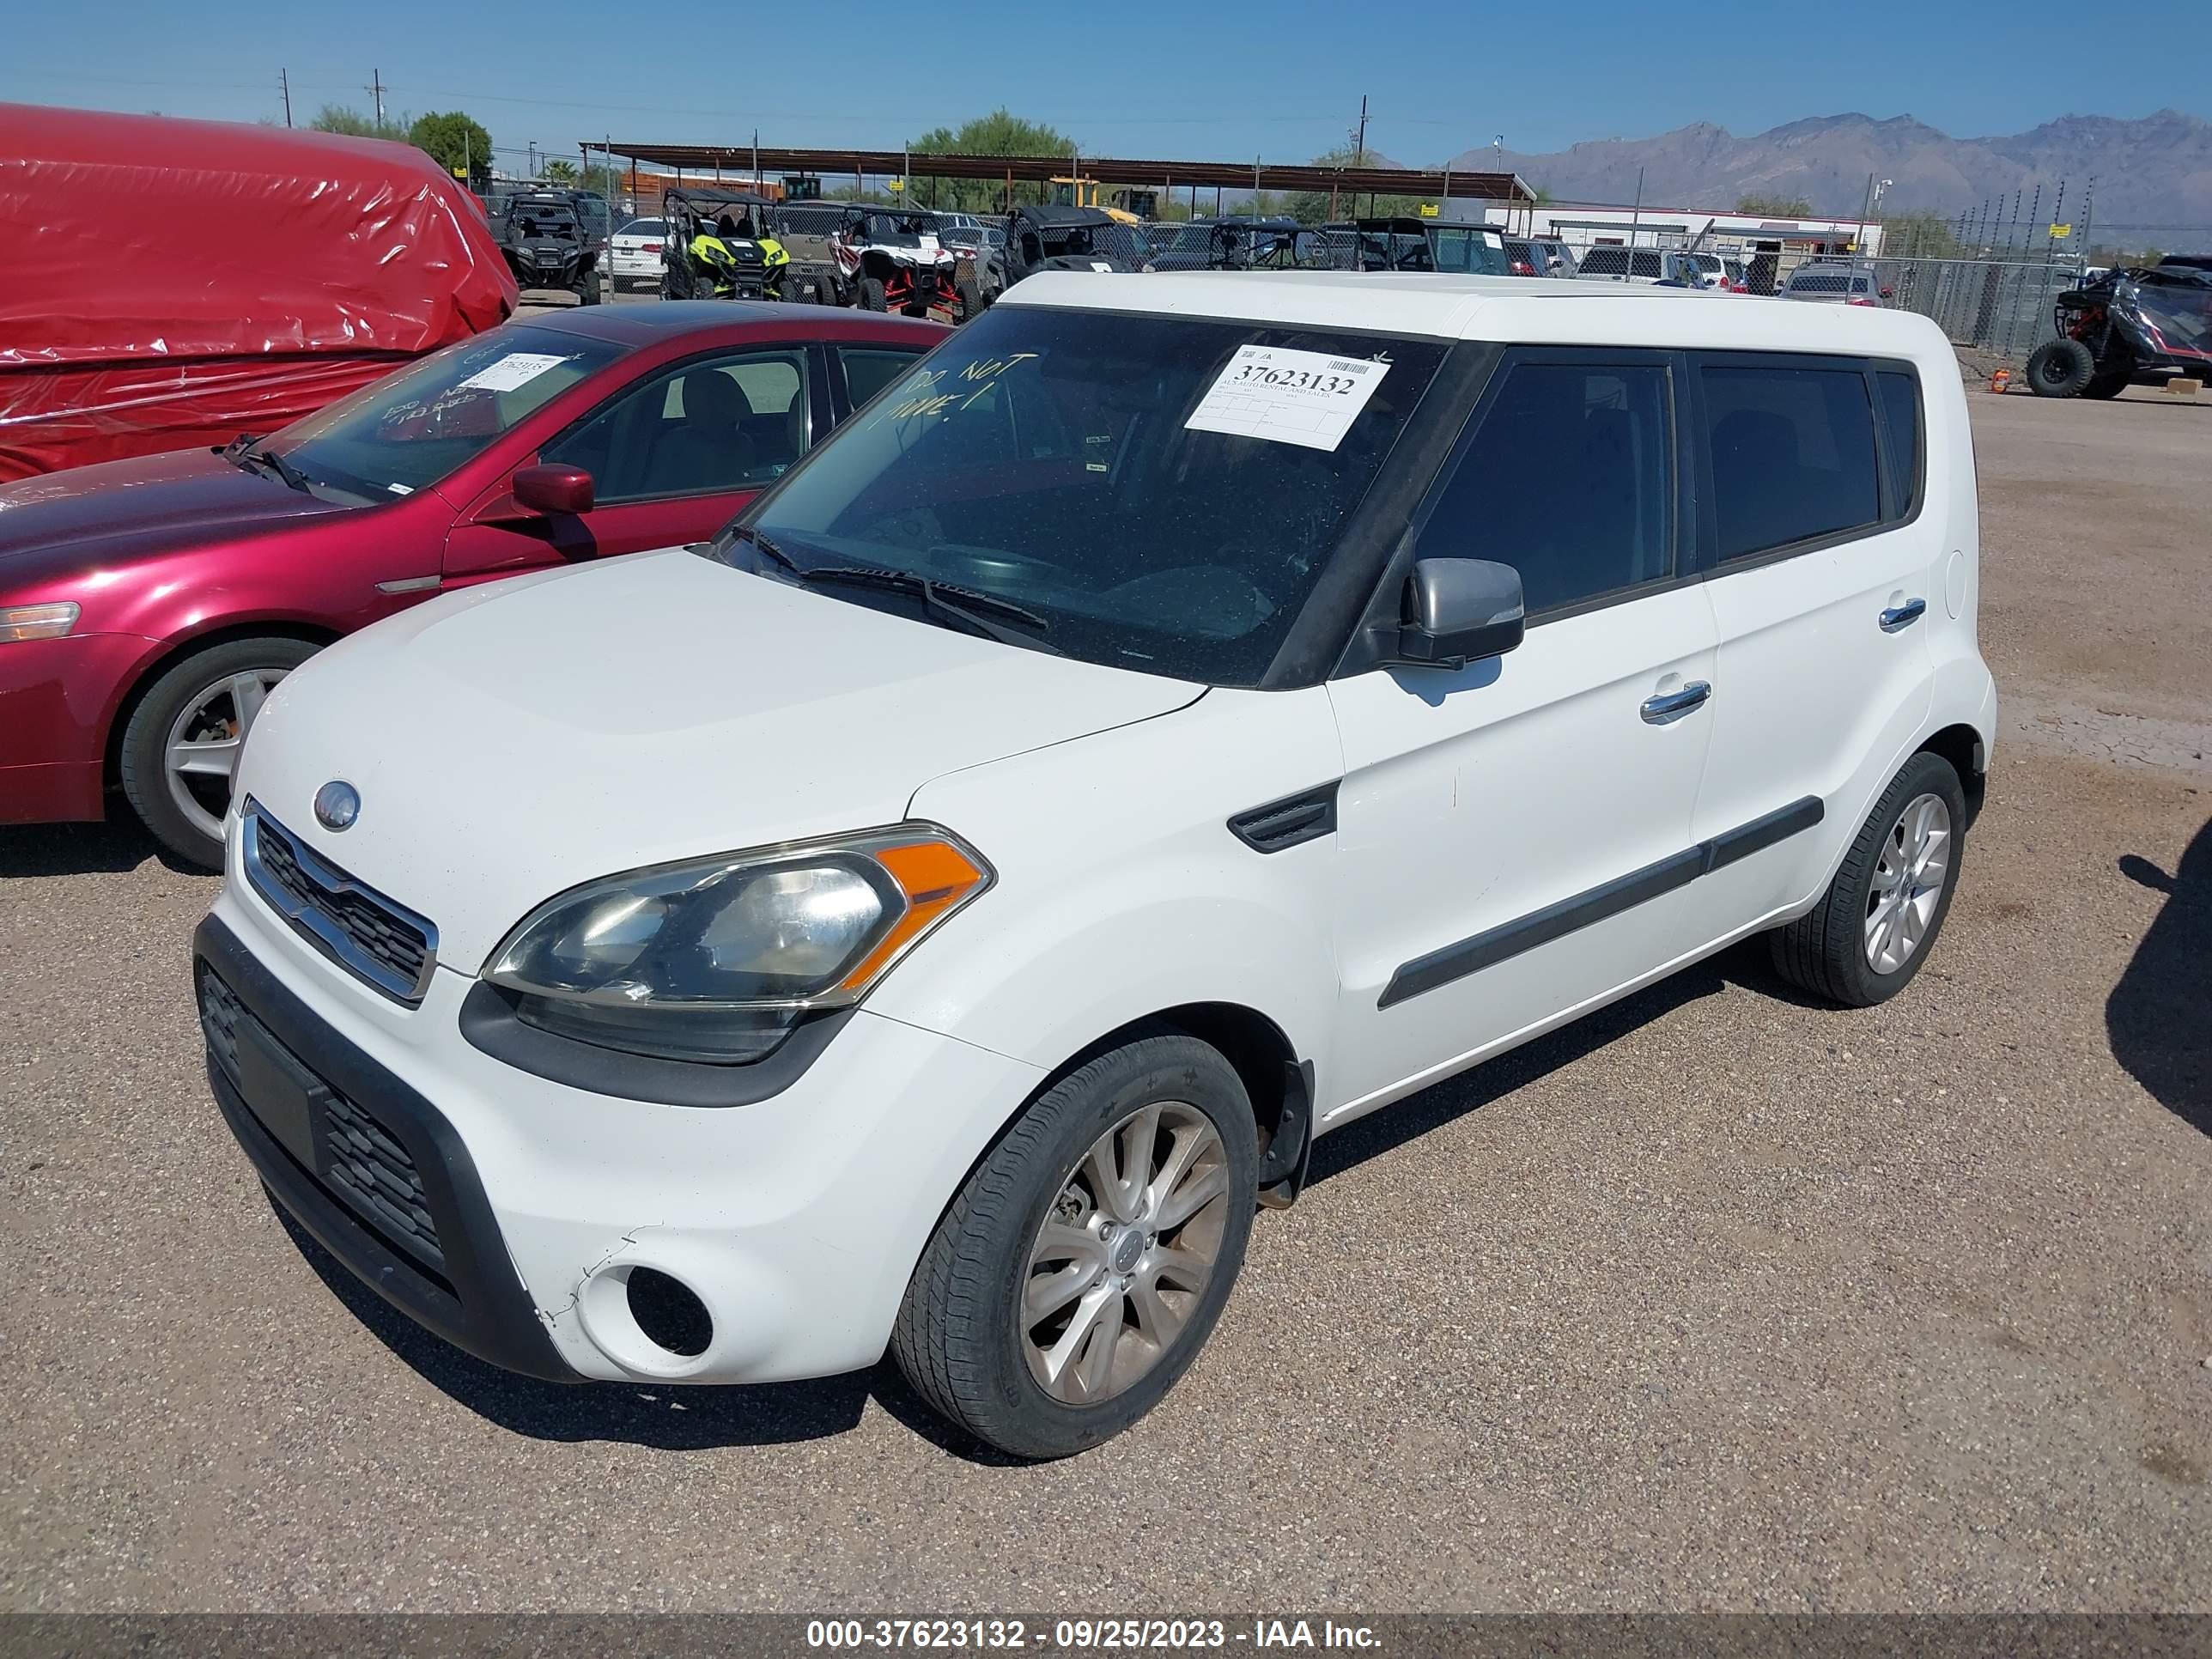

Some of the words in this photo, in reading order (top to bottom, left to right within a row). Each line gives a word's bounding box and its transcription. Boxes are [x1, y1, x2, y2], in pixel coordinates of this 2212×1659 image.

[905, 370, 948, 393] DO
[958, 353, 1040, 382] NOT
[1234, 365, 1357, 396] 37623132
[1260, 384, 1288, 392] RENTAL
[1307, 390, 1330, 398] SALES
